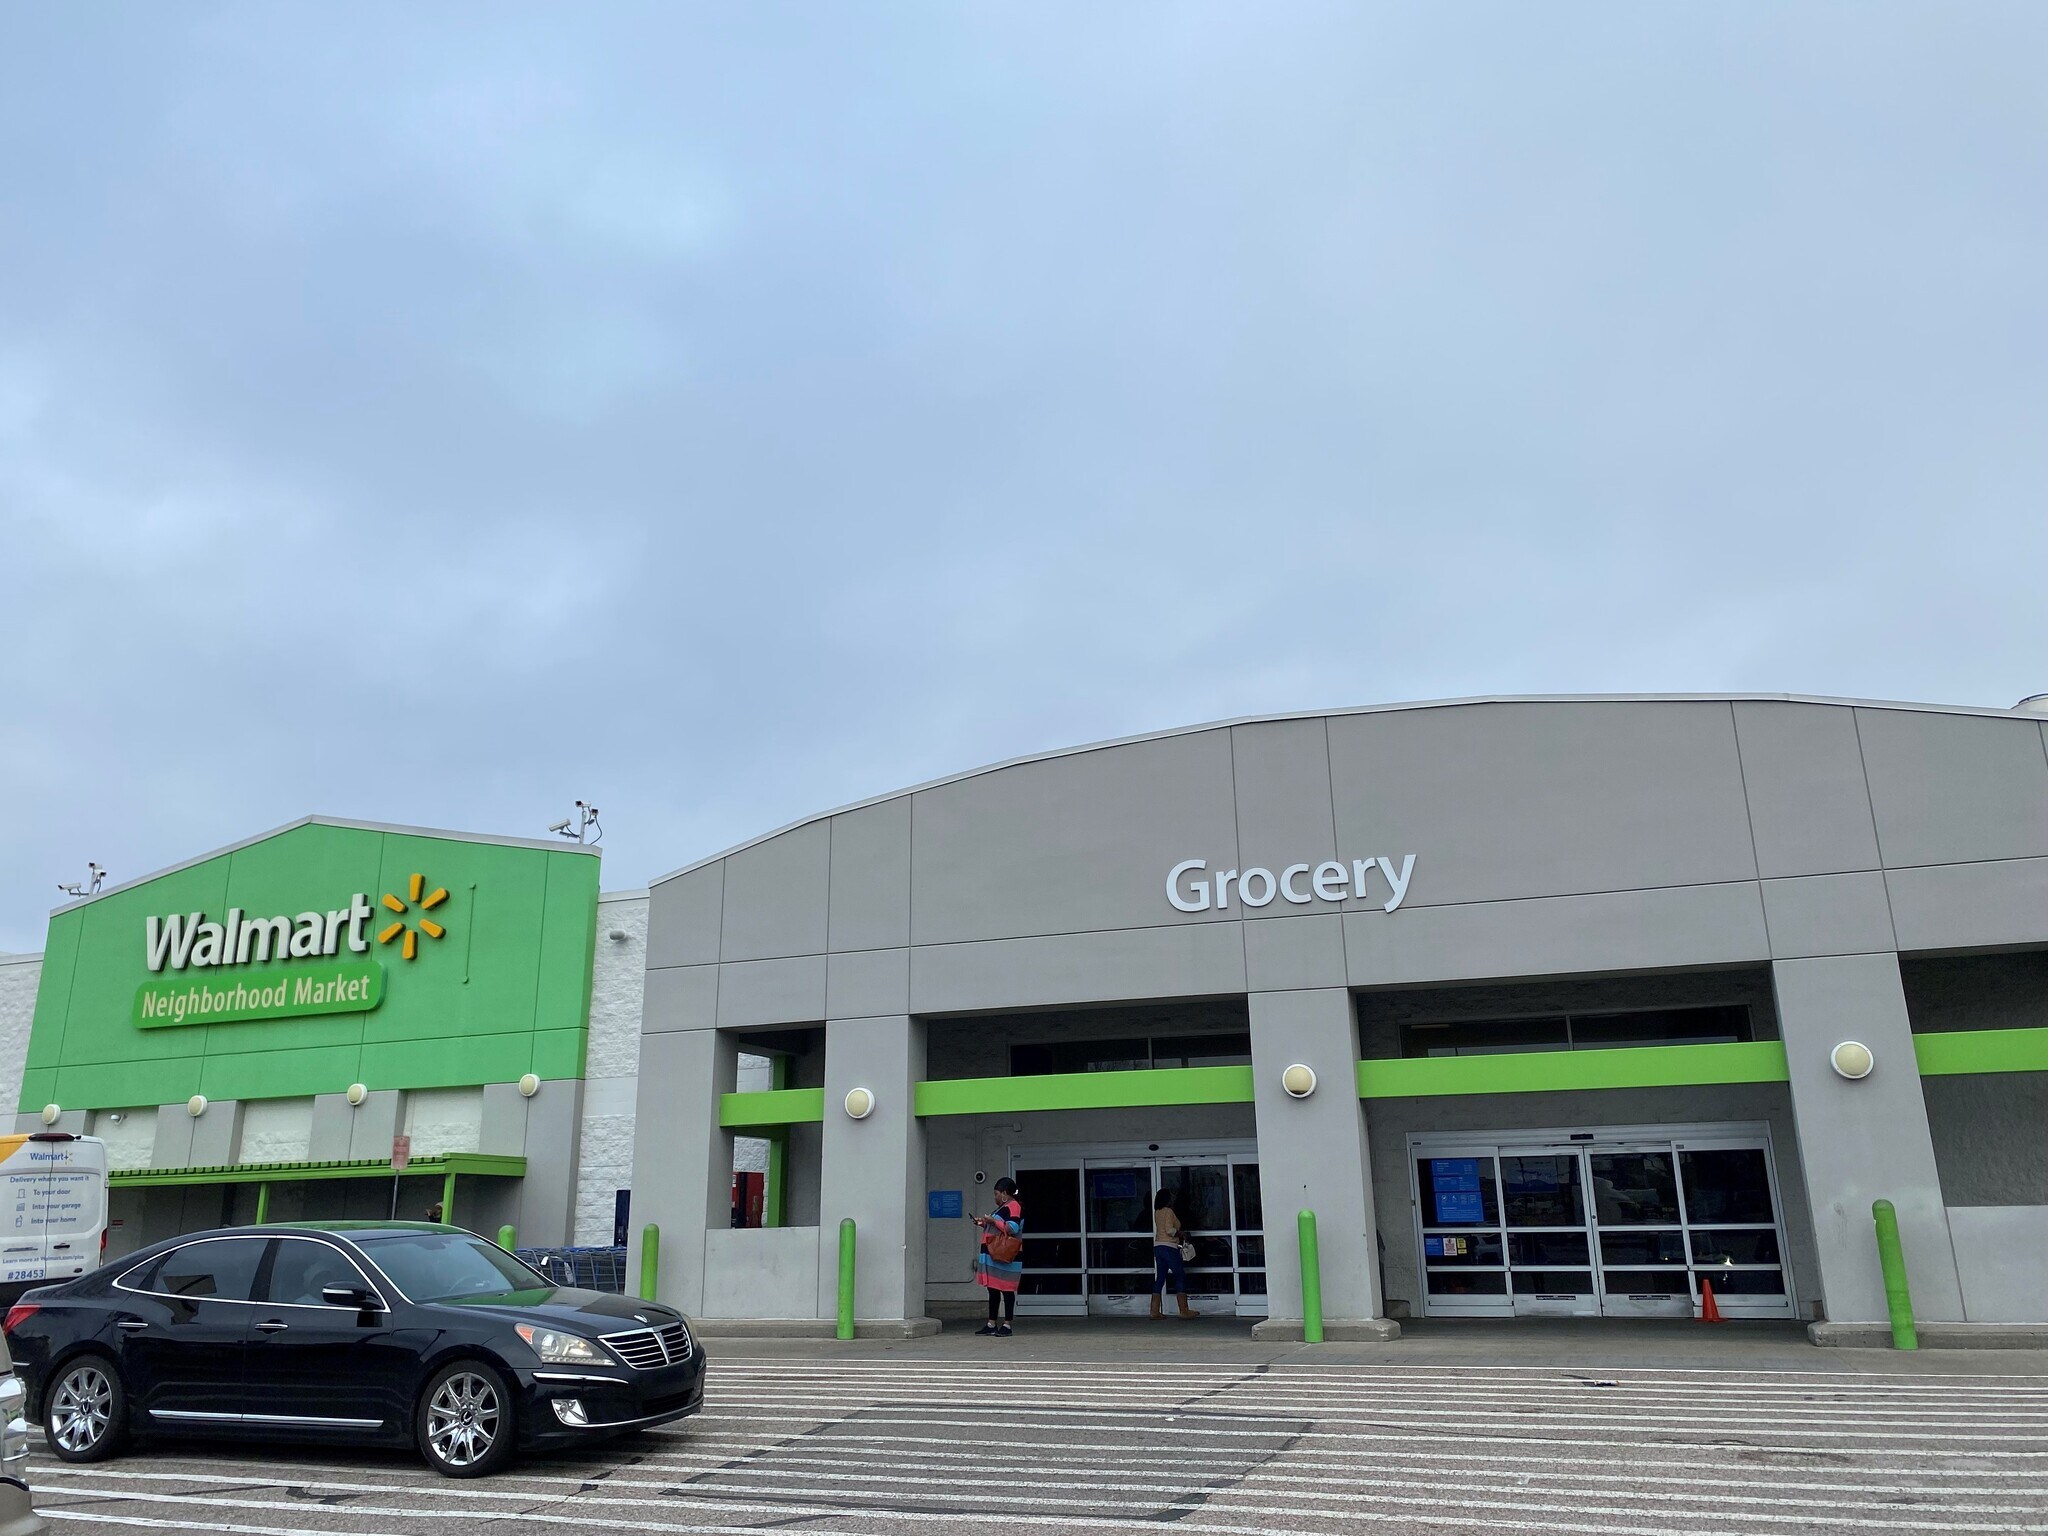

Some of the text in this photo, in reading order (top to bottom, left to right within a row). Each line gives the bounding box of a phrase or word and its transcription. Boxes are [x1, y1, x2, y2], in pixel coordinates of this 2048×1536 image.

[1166, 854, 1417, 914] Grocery
[145, 893, 373, 972] Walmart
[141, 974, 370, 1023] Neighborhood Market
[9, 1176, 37, 1184] Delivery
[7, 1269, 44, 1281] #28453
